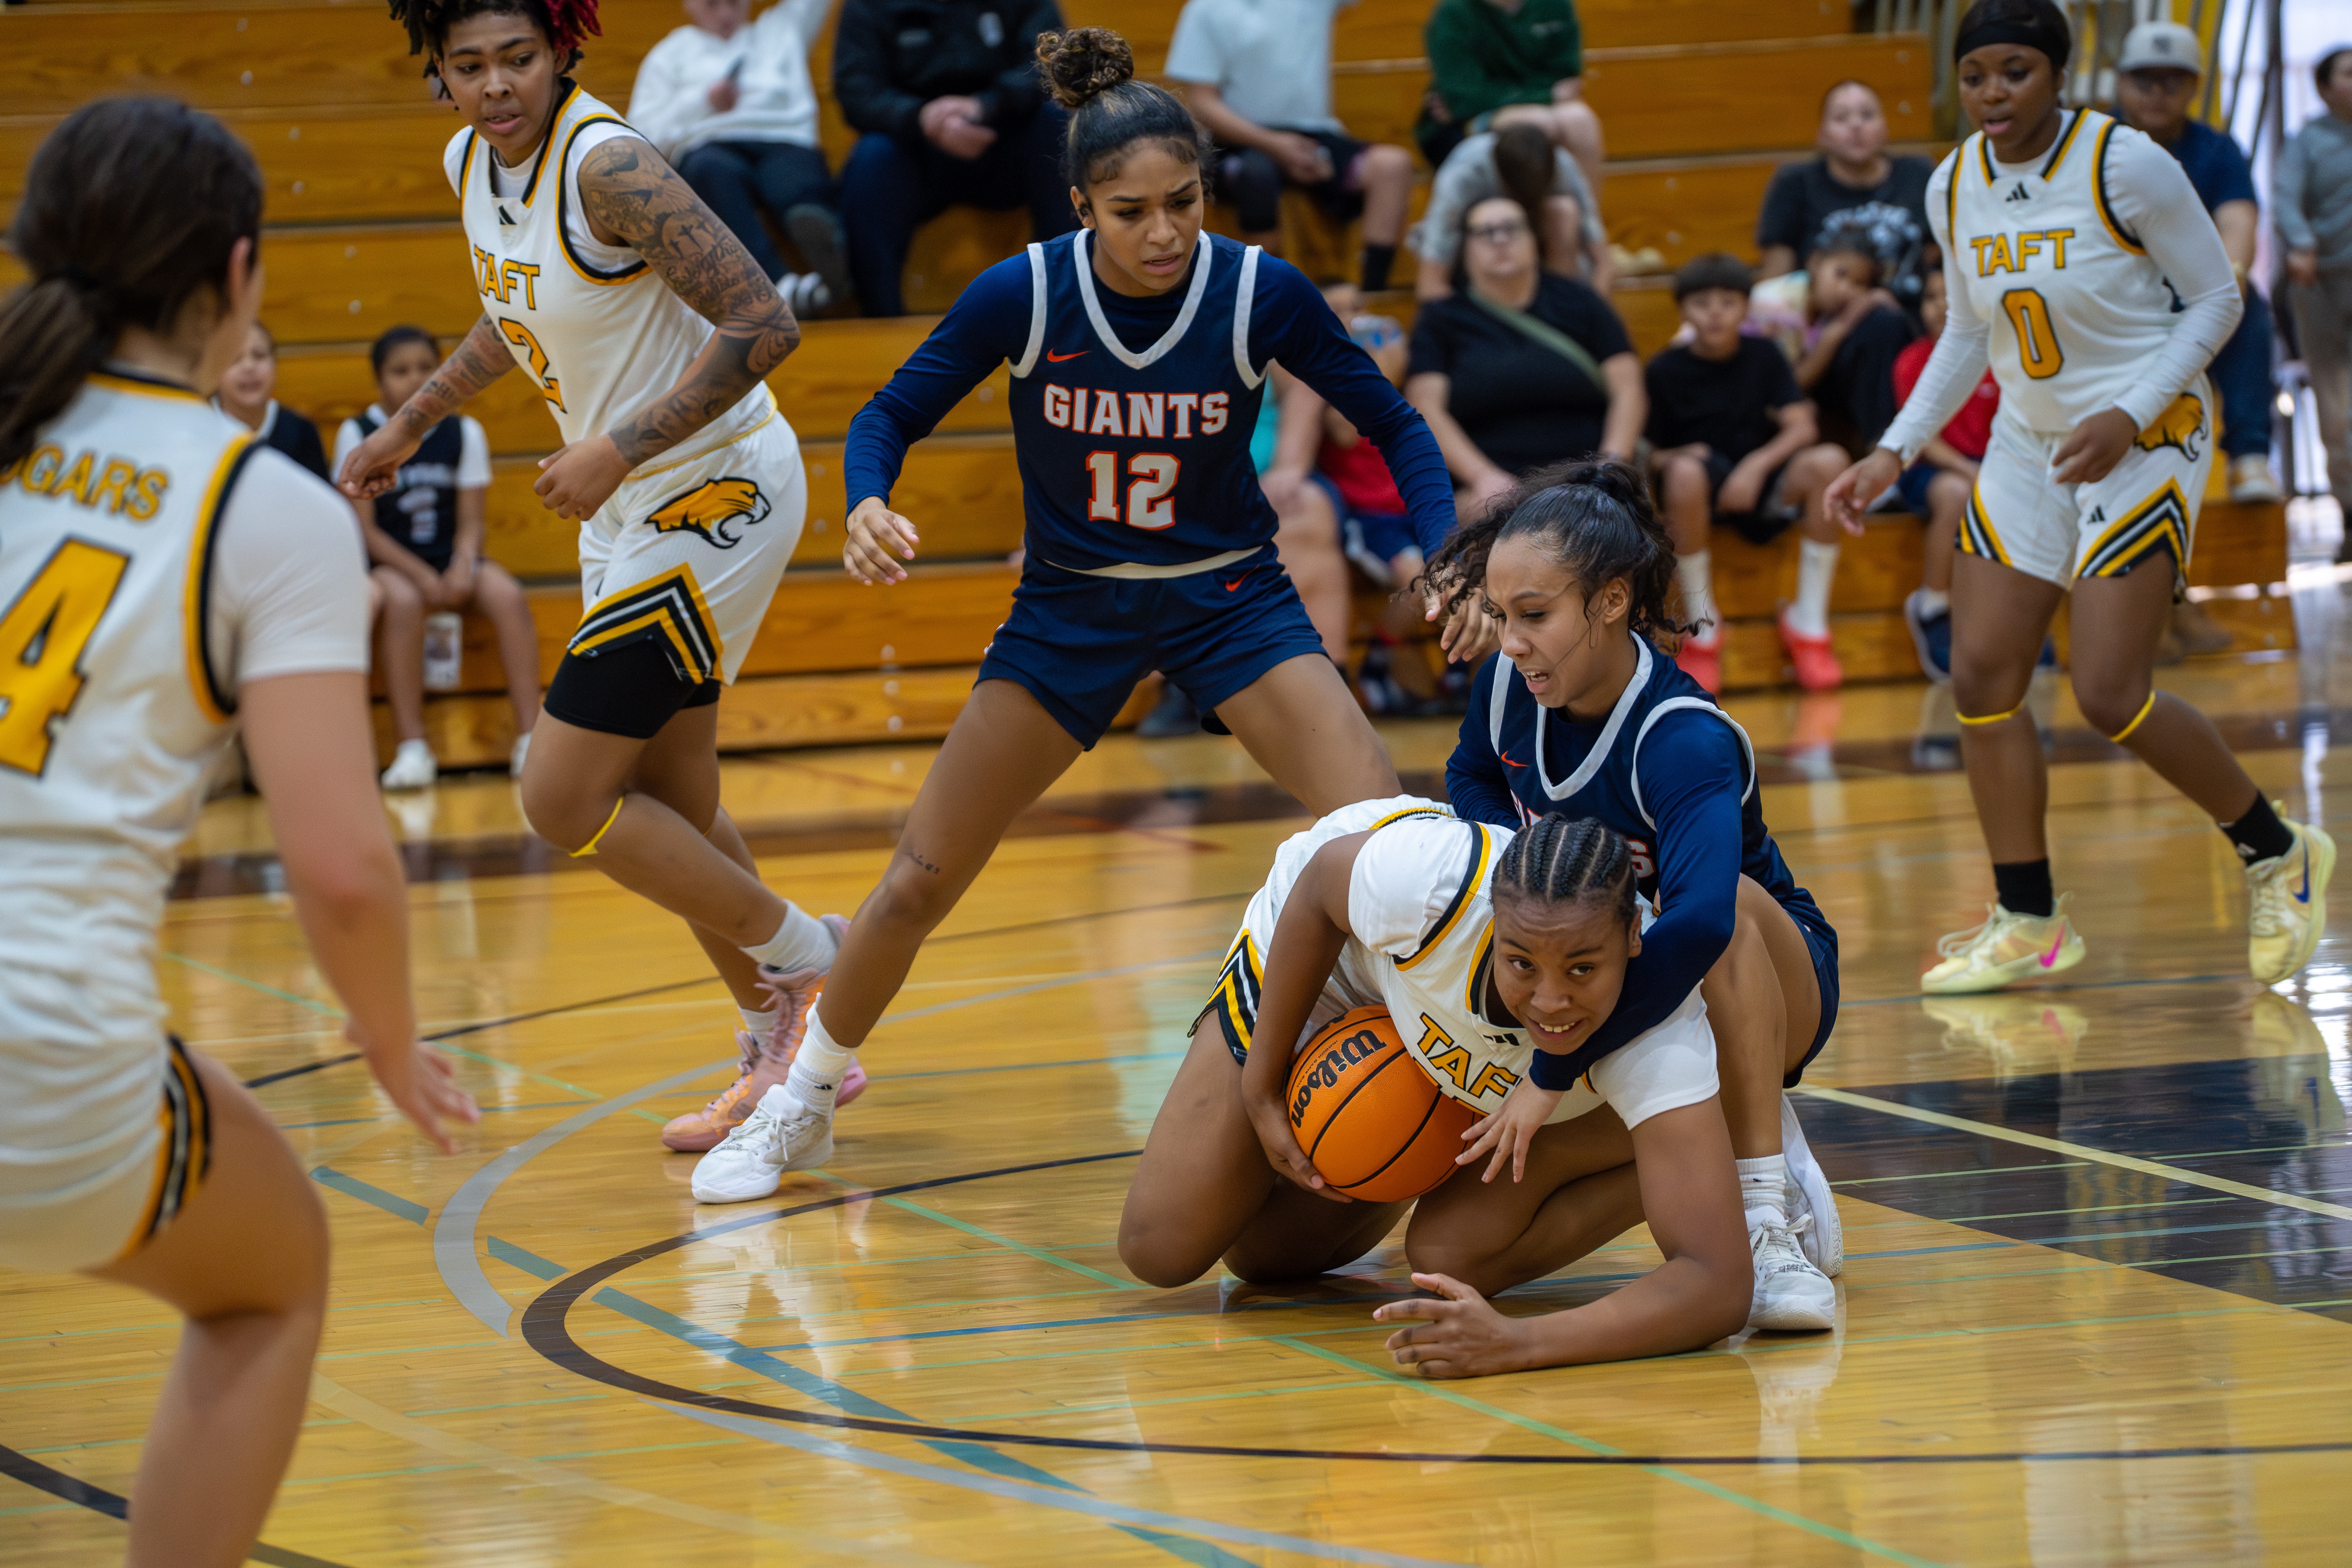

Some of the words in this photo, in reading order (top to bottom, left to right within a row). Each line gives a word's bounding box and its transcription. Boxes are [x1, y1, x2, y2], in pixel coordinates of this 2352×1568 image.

[474, 244, 540, 310] TAFT
[1970, 228, 2075, 278] TAFT
[2001, 286, 2064, 379] 0
[1043, 382, 1230, 439] GIANTS
[1085, 450, 1181, 531] 12
[0, 534, 132, 779] 4
[1291, 1029, 1387, 1128] Wilson
[1417, 1012, 1523, 1099] TAF
